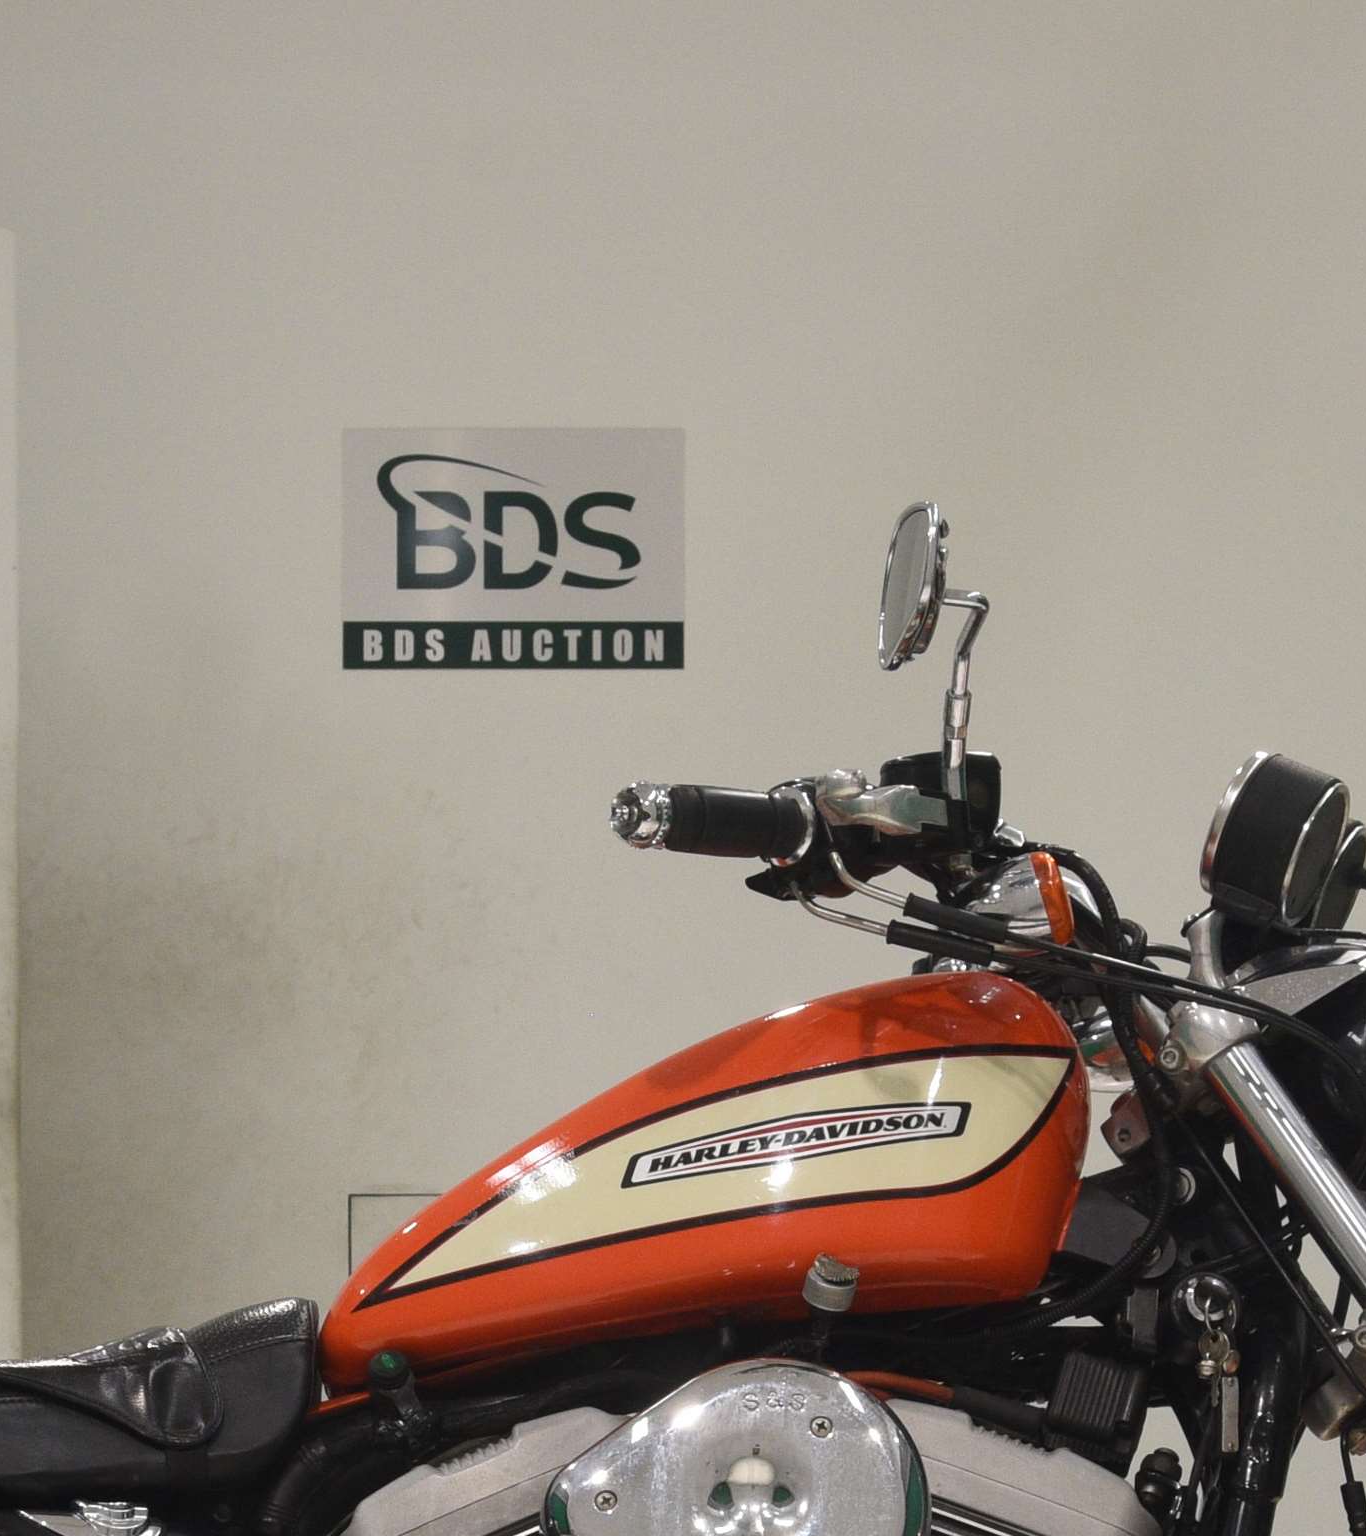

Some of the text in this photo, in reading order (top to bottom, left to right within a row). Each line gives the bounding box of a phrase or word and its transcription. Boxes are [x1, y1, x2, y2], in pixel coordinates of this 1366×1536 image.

[377, 454, 641, 591] BDS
[362, 629, 664, 662] BDS AUCTION
[649, 1111, 946, 1173] HARLEY-DAVIDSON
